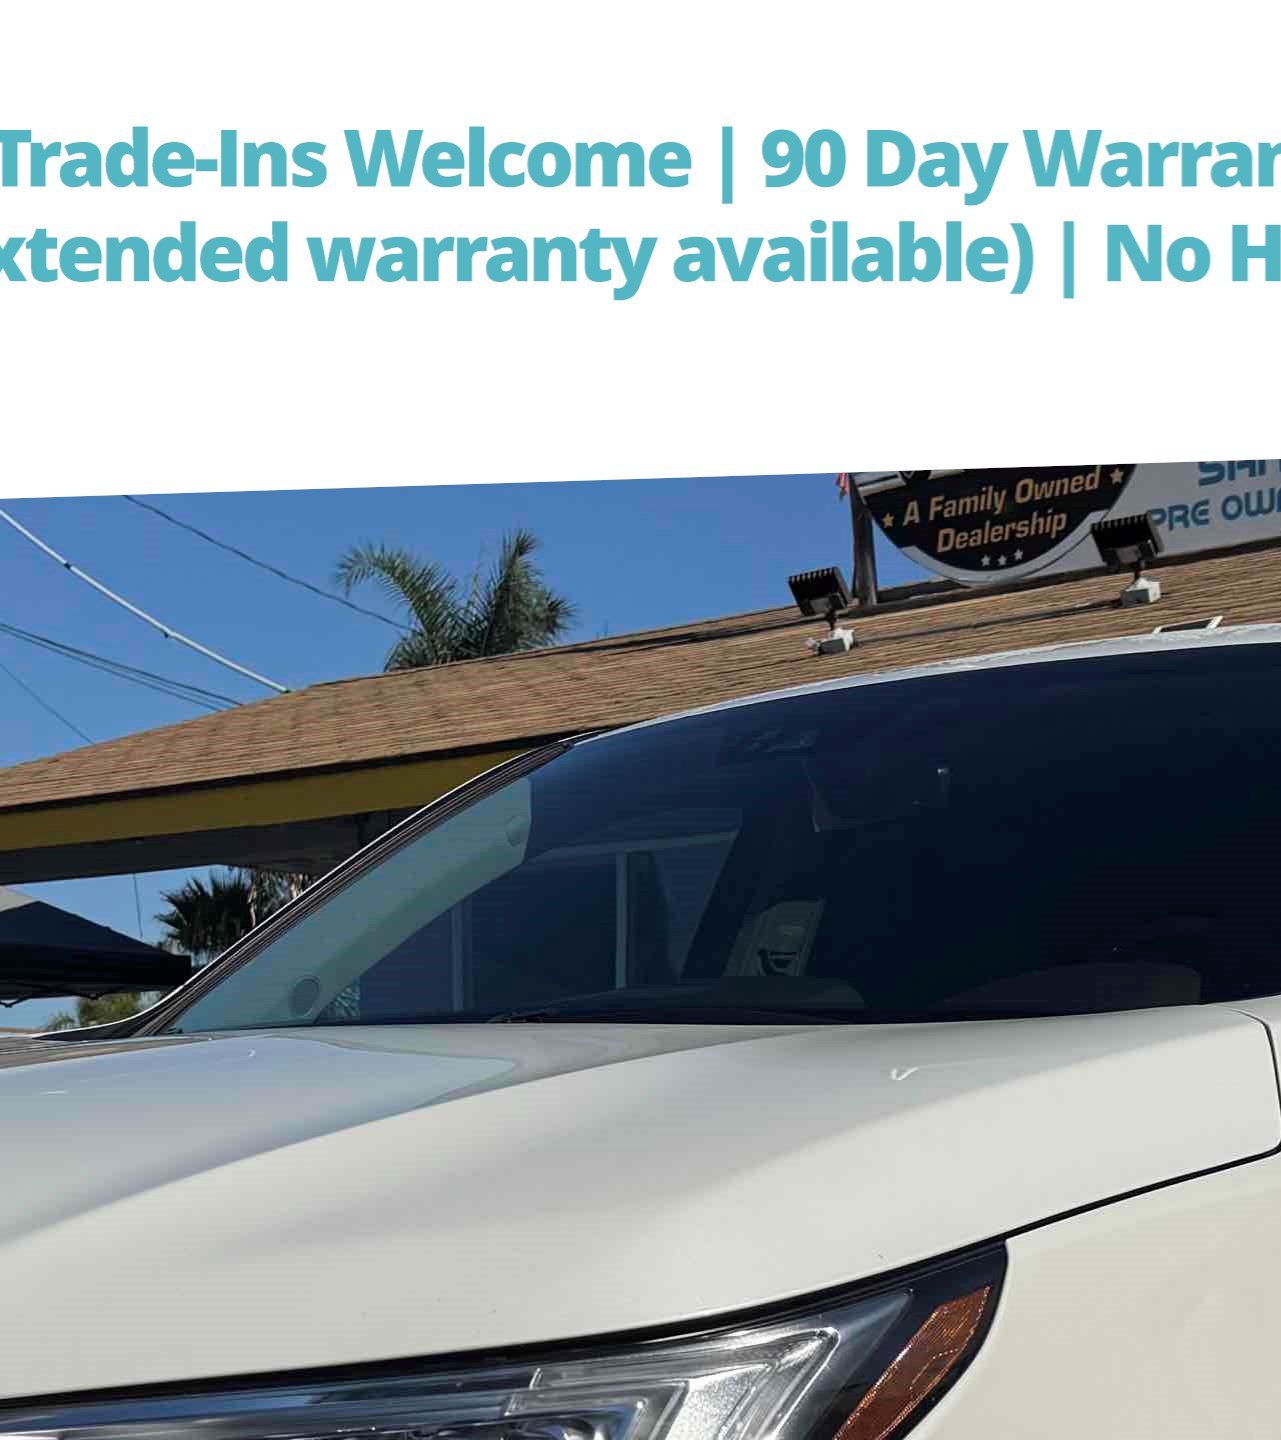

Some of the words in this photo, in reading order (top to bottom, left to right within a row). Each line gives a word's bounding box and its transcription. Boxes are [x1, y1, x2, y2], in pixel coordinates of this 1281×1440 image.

[902, 500, 920, 526] A
[928, 486, 1008, 522] Family
[1015, 465, 1102, 504] Owned
[1150, 498, 1210, 531] PRE
[936, 510, 1067, 553] Dealership
